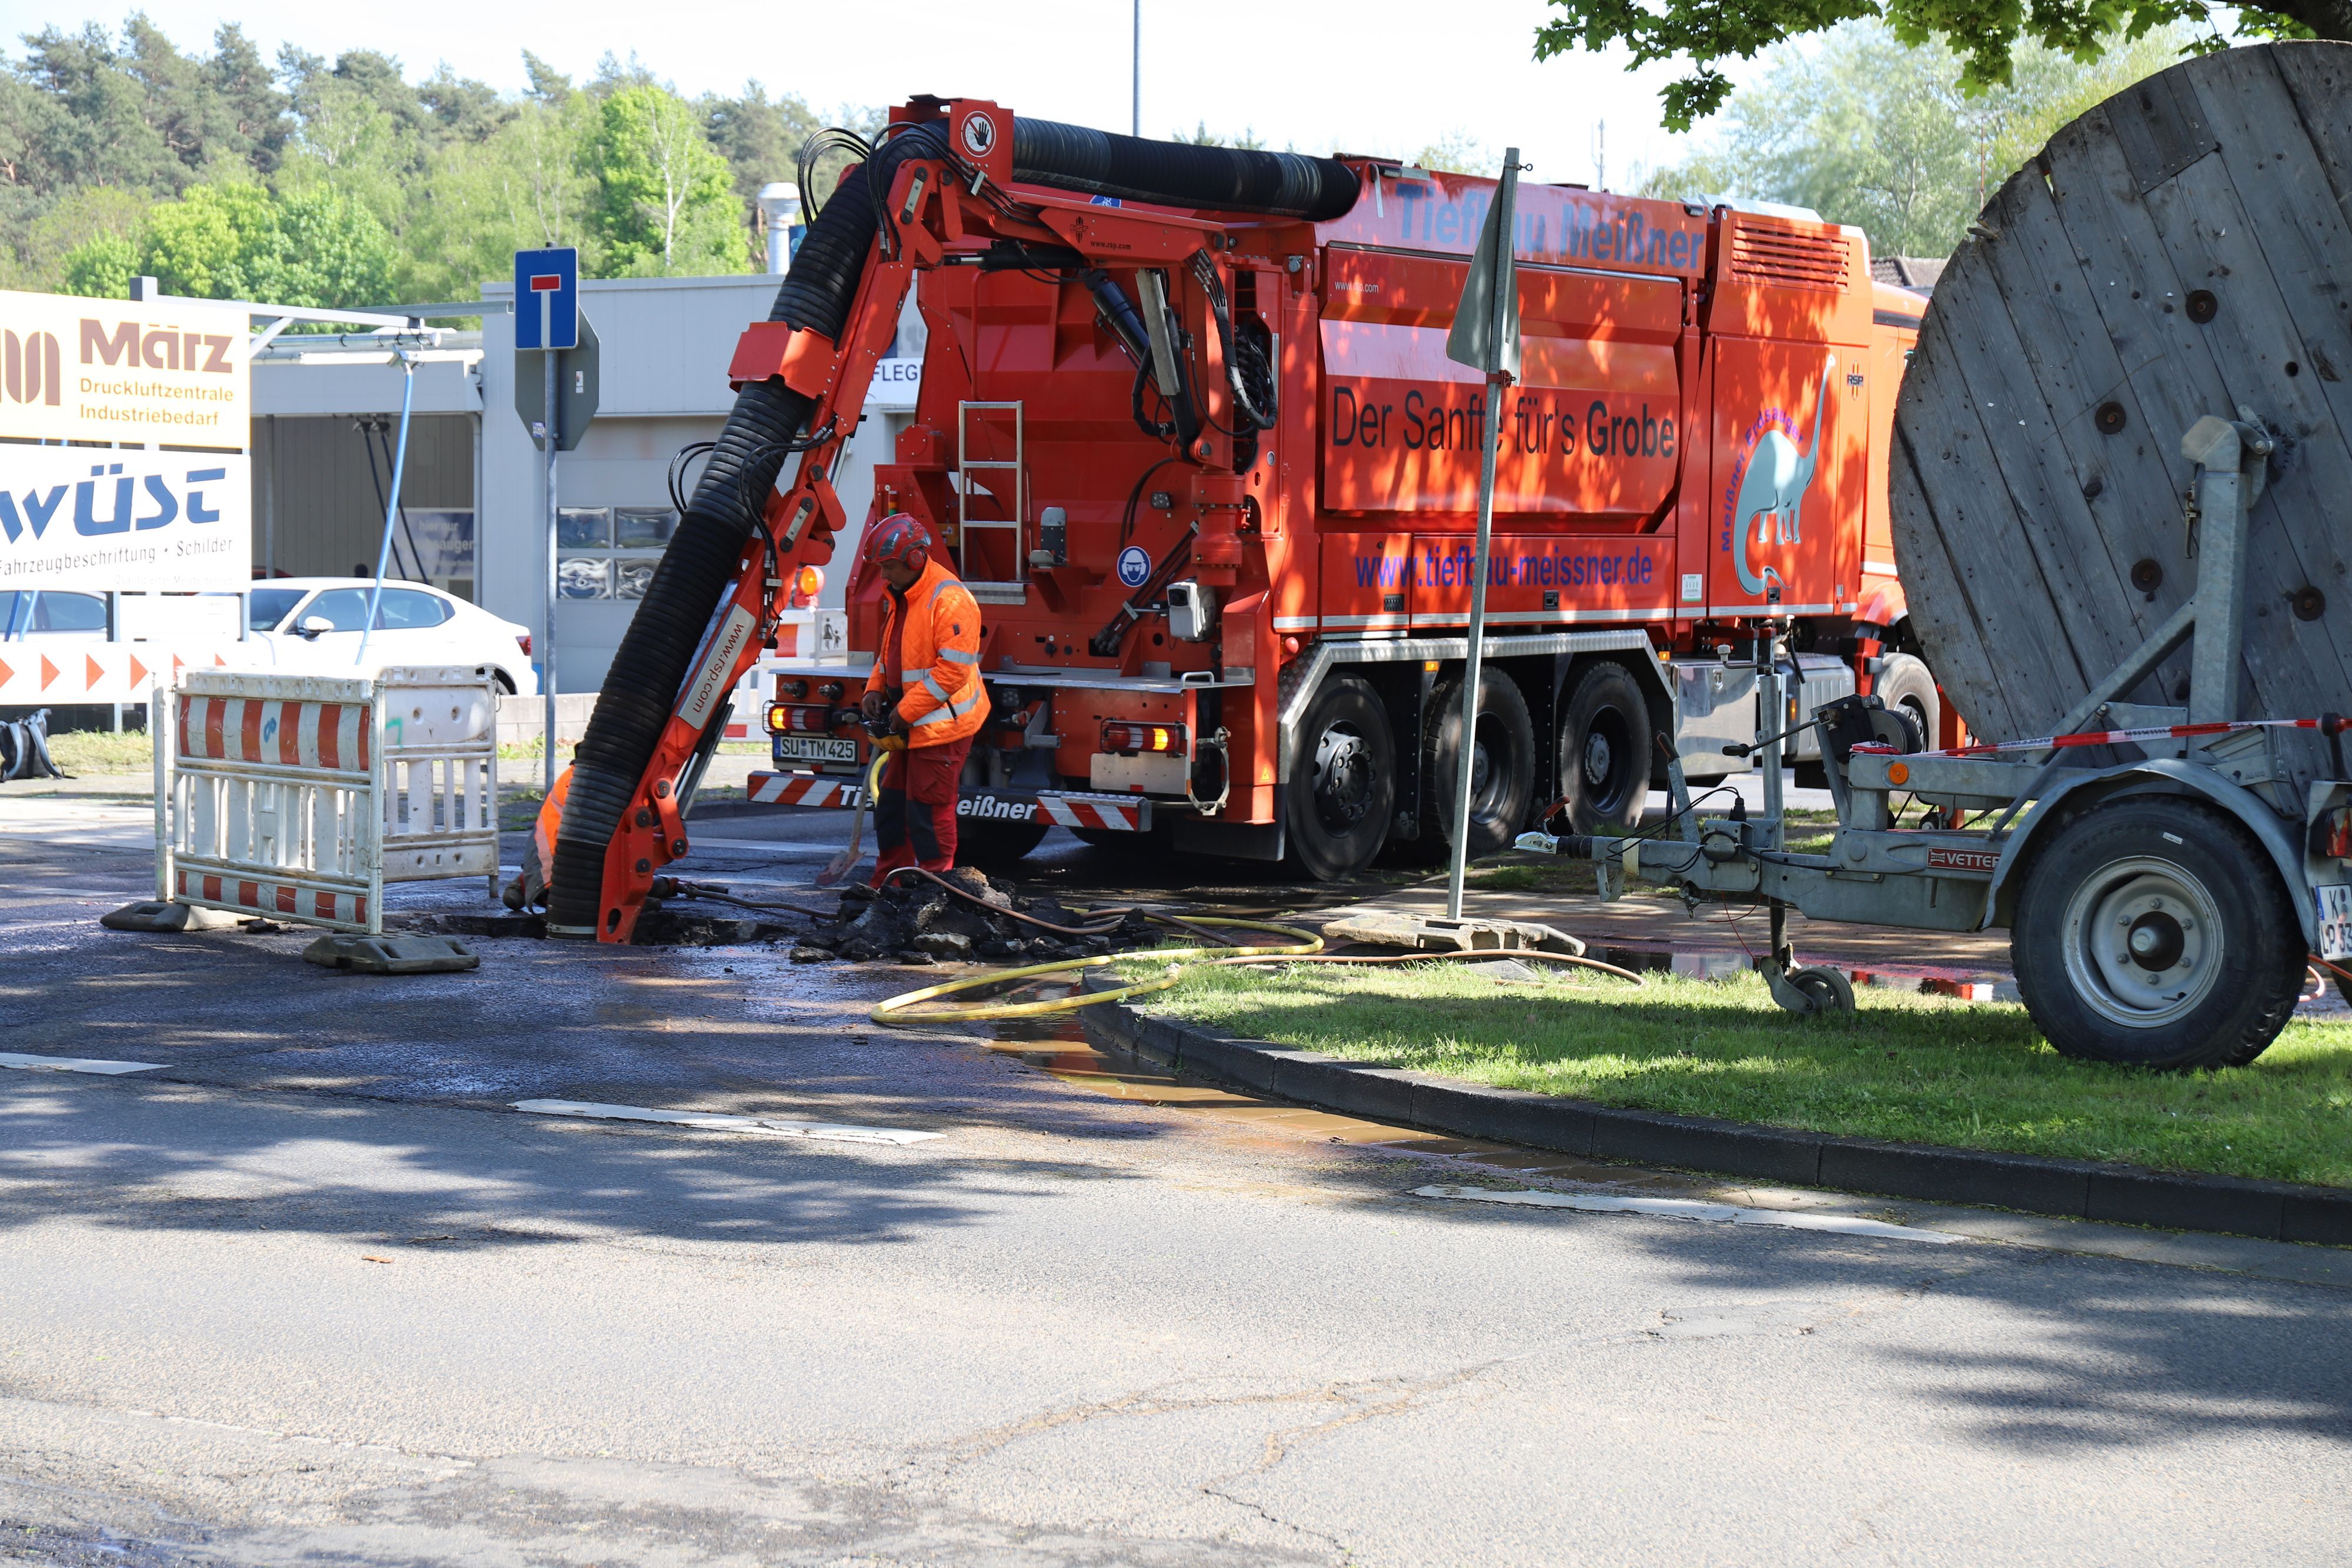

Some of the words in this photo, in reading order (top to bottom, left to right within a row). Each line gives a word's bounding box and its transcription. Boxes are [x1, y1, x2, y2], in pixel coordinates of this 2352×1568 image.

[1090, 240, 1132, 250] www.rsp.com
[1559, 203, 1704, 269] Meißner
[80, 318, 233, 374] März
[871, 363, 923, 382] FLEG
[1847, 374, 1864, 386] RSP
[80, 377, 233, 402] Druckluftzentrale
[80, 403, 218, 425] Industriebedarf
[1333, 386, 1393, 448] Der
[1587, 400, 1675, 458] Grobe
[1722, 448, 1746, 552] Meißner
[1744, 407, 1804, 447] Erdsauger
[176, 537, 233, 557] Schilder
[693, 623, 744, 713] www.rsp.com
[782, 738, 799, 755] SU
[808, 740, 826, 757] TM
[828, 741, 853, 758] 425
[956, 795, 1038, 820] eißner
[2329, 890, 2339, 919] K
